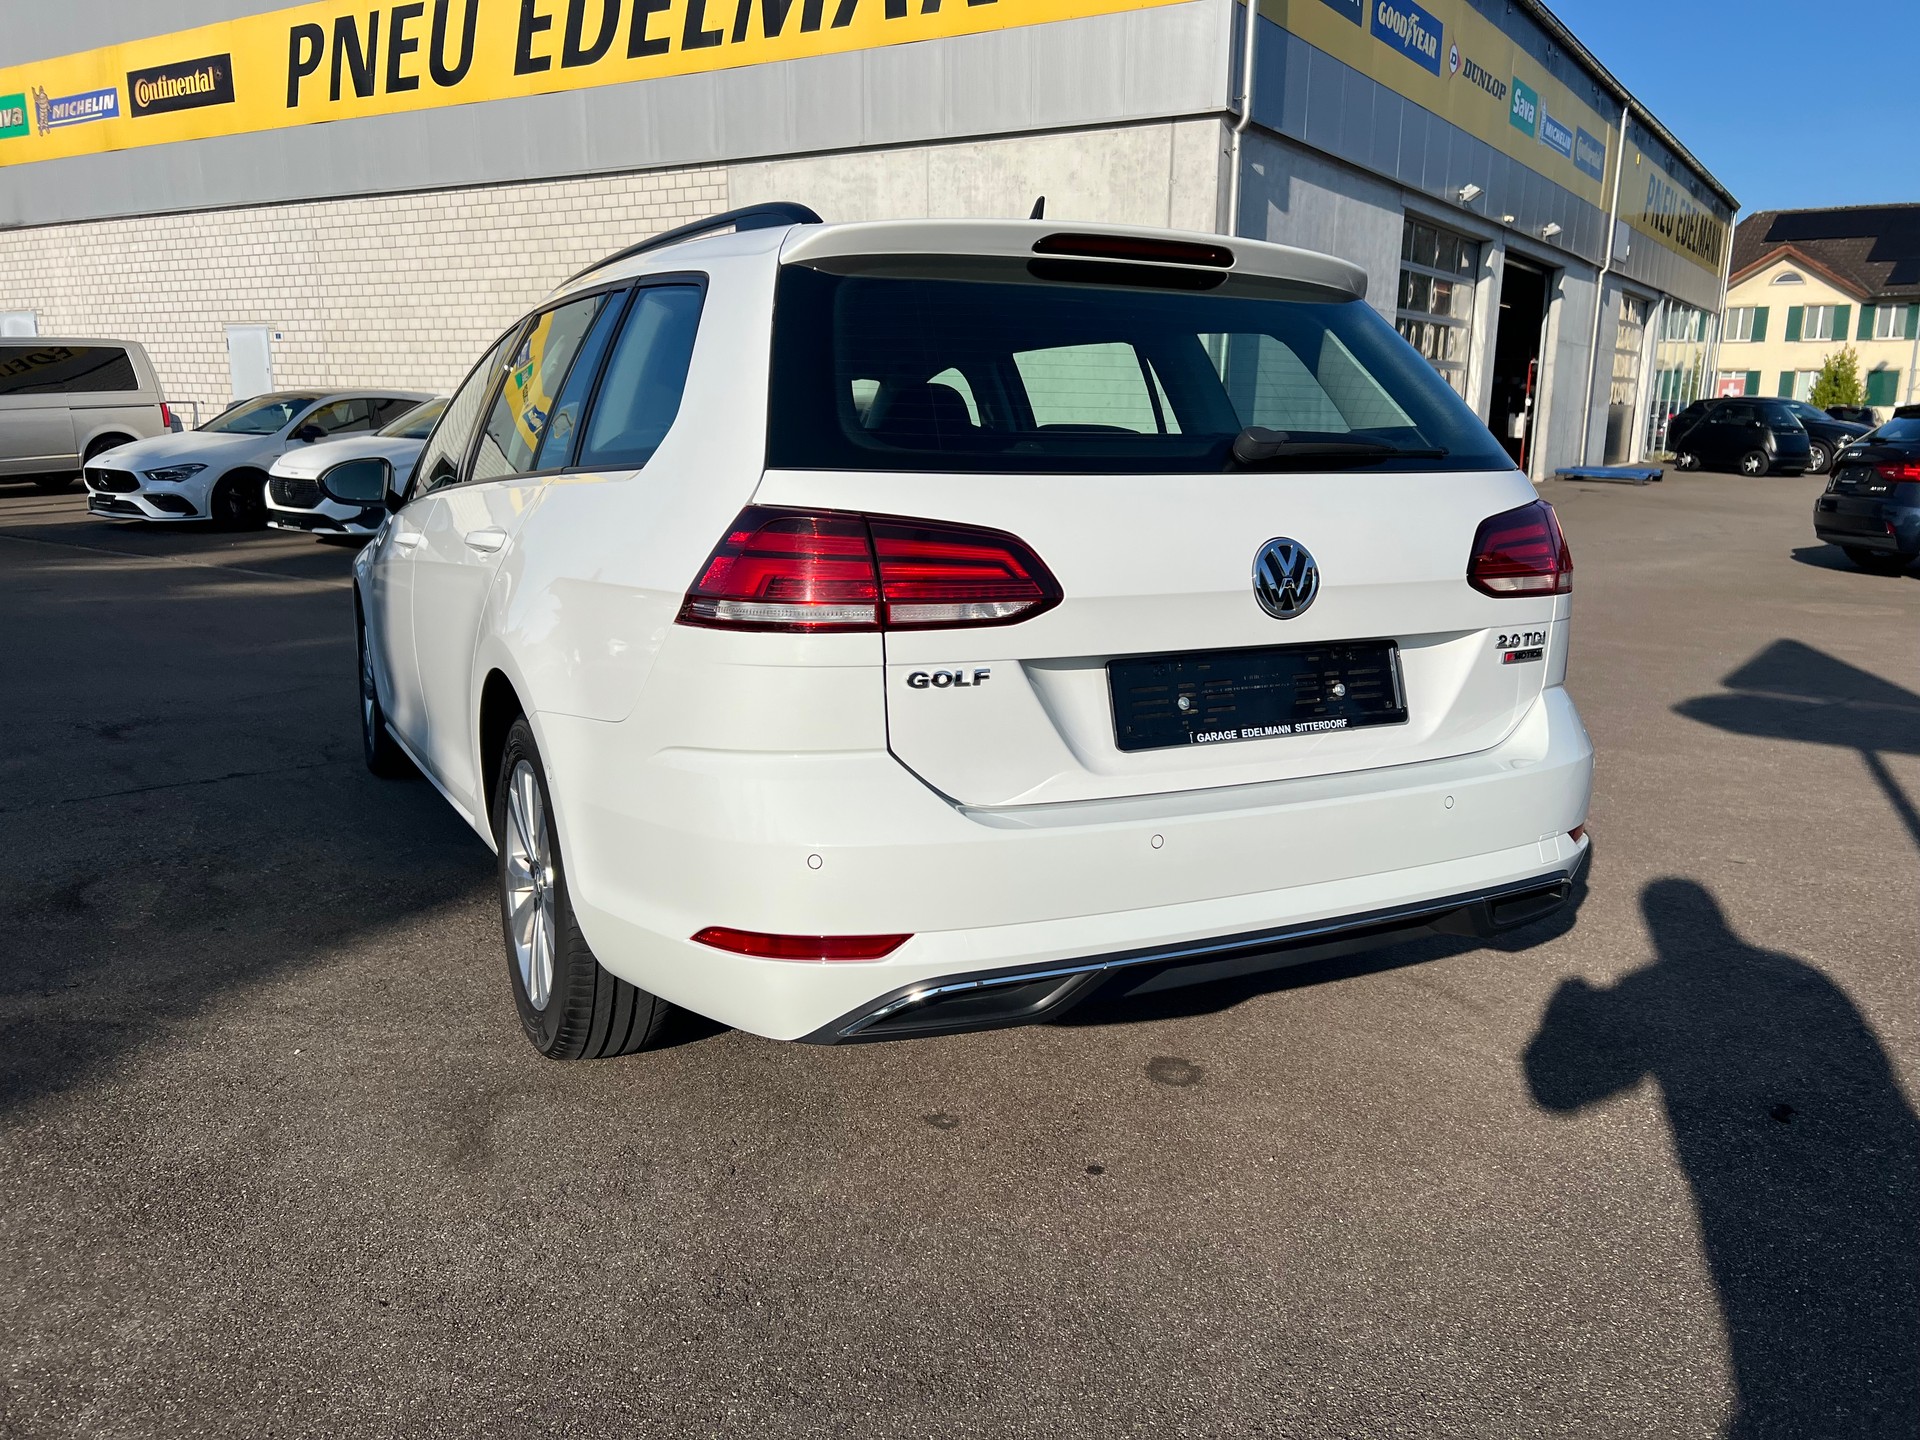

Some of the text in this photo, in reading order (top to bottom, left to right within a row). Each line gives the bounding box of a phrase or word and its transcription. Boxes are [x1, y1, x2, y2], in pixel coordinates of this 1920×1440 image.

[1378, 1, 1437, 59] GOODYEAR
[286, 0, 478, 108] PNEU
[135, 66, 216, 108] Continental
[1463, 57, 1507, 101] DUNLOP
[53, 94, 114, 119] MICHELIN
[1512, 88, 1535, 124] Sava
[1546, 121, 1572, 151] MICHELIN
[1643, 173, 1722, 268] PNEU EDELMANN
[1495, 630, 1546, 649] 2.0 TDI
[906, 668, 990, 689] GOLF
[1196, 719, 1348, 743] GARAGE EDELMANN SITTERDORF
